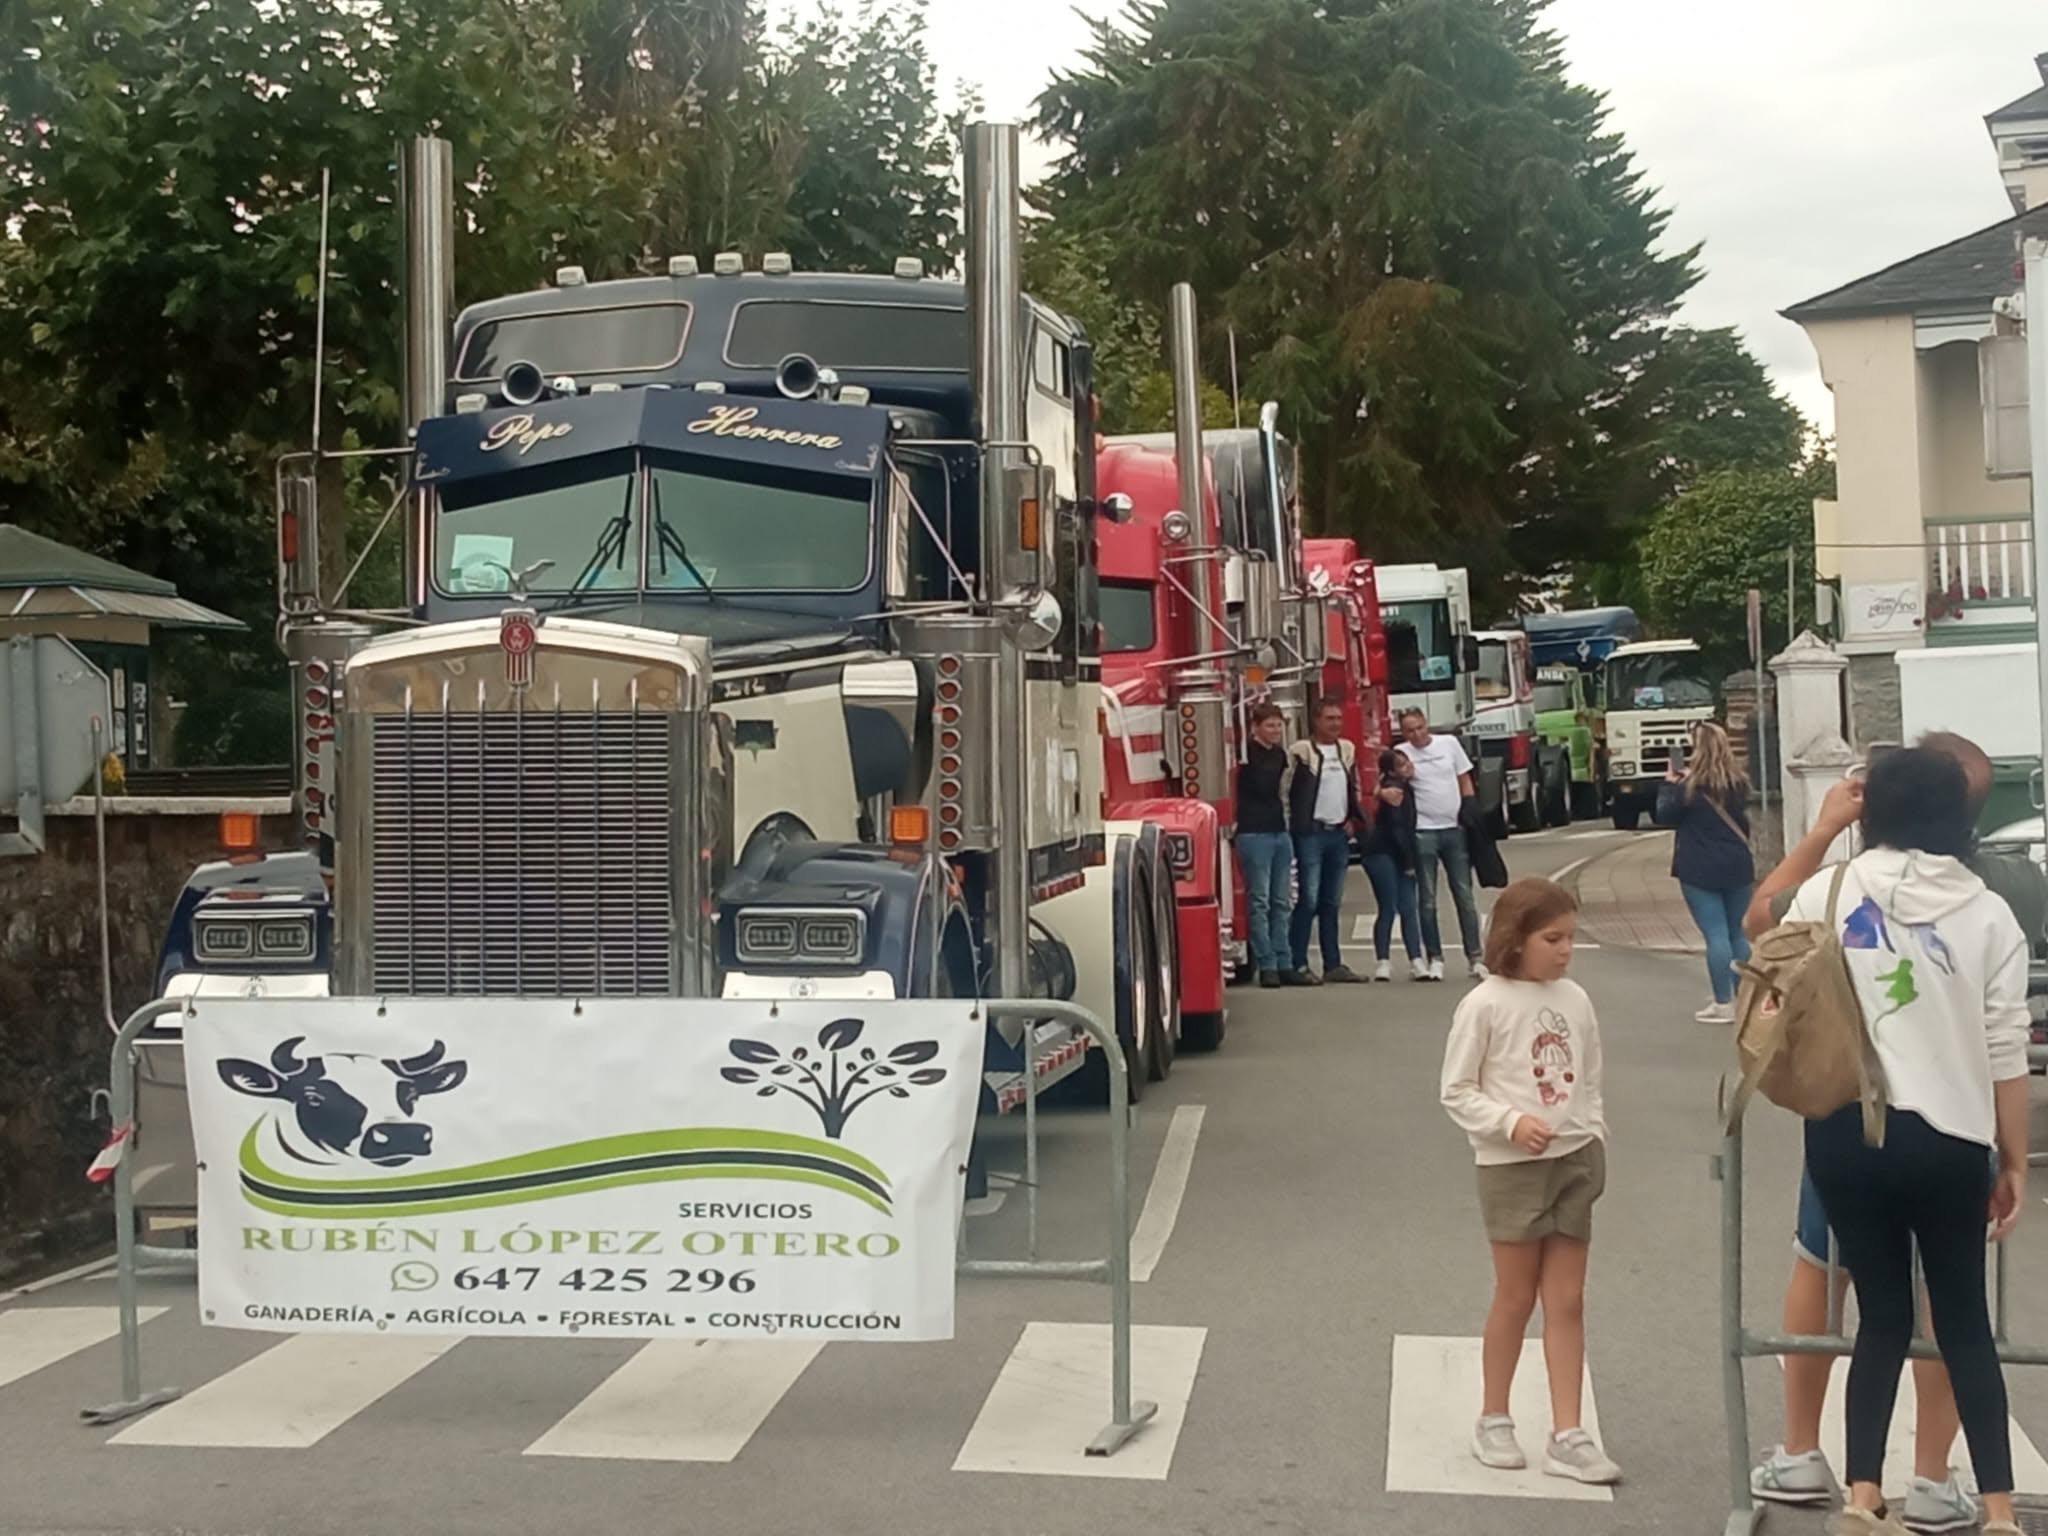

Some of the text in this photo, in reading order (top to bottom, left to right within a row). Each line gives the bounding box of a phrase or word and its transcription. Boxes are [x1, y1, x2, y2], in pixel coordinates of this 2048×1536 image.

[479, 405, 843, 456] Pepe Herrera
[678, 1202, 813, 1220] SERVICIOS
[241, 1222, 901, 1258] RUBÉN LÓPEZ OTERO
[453, 1266, 757, 1294] 647 425 296
[244, 1304, 901, 1330] GANADERÍA AGRÍCOLA FORESTAL CONSTRUCCIÓN
